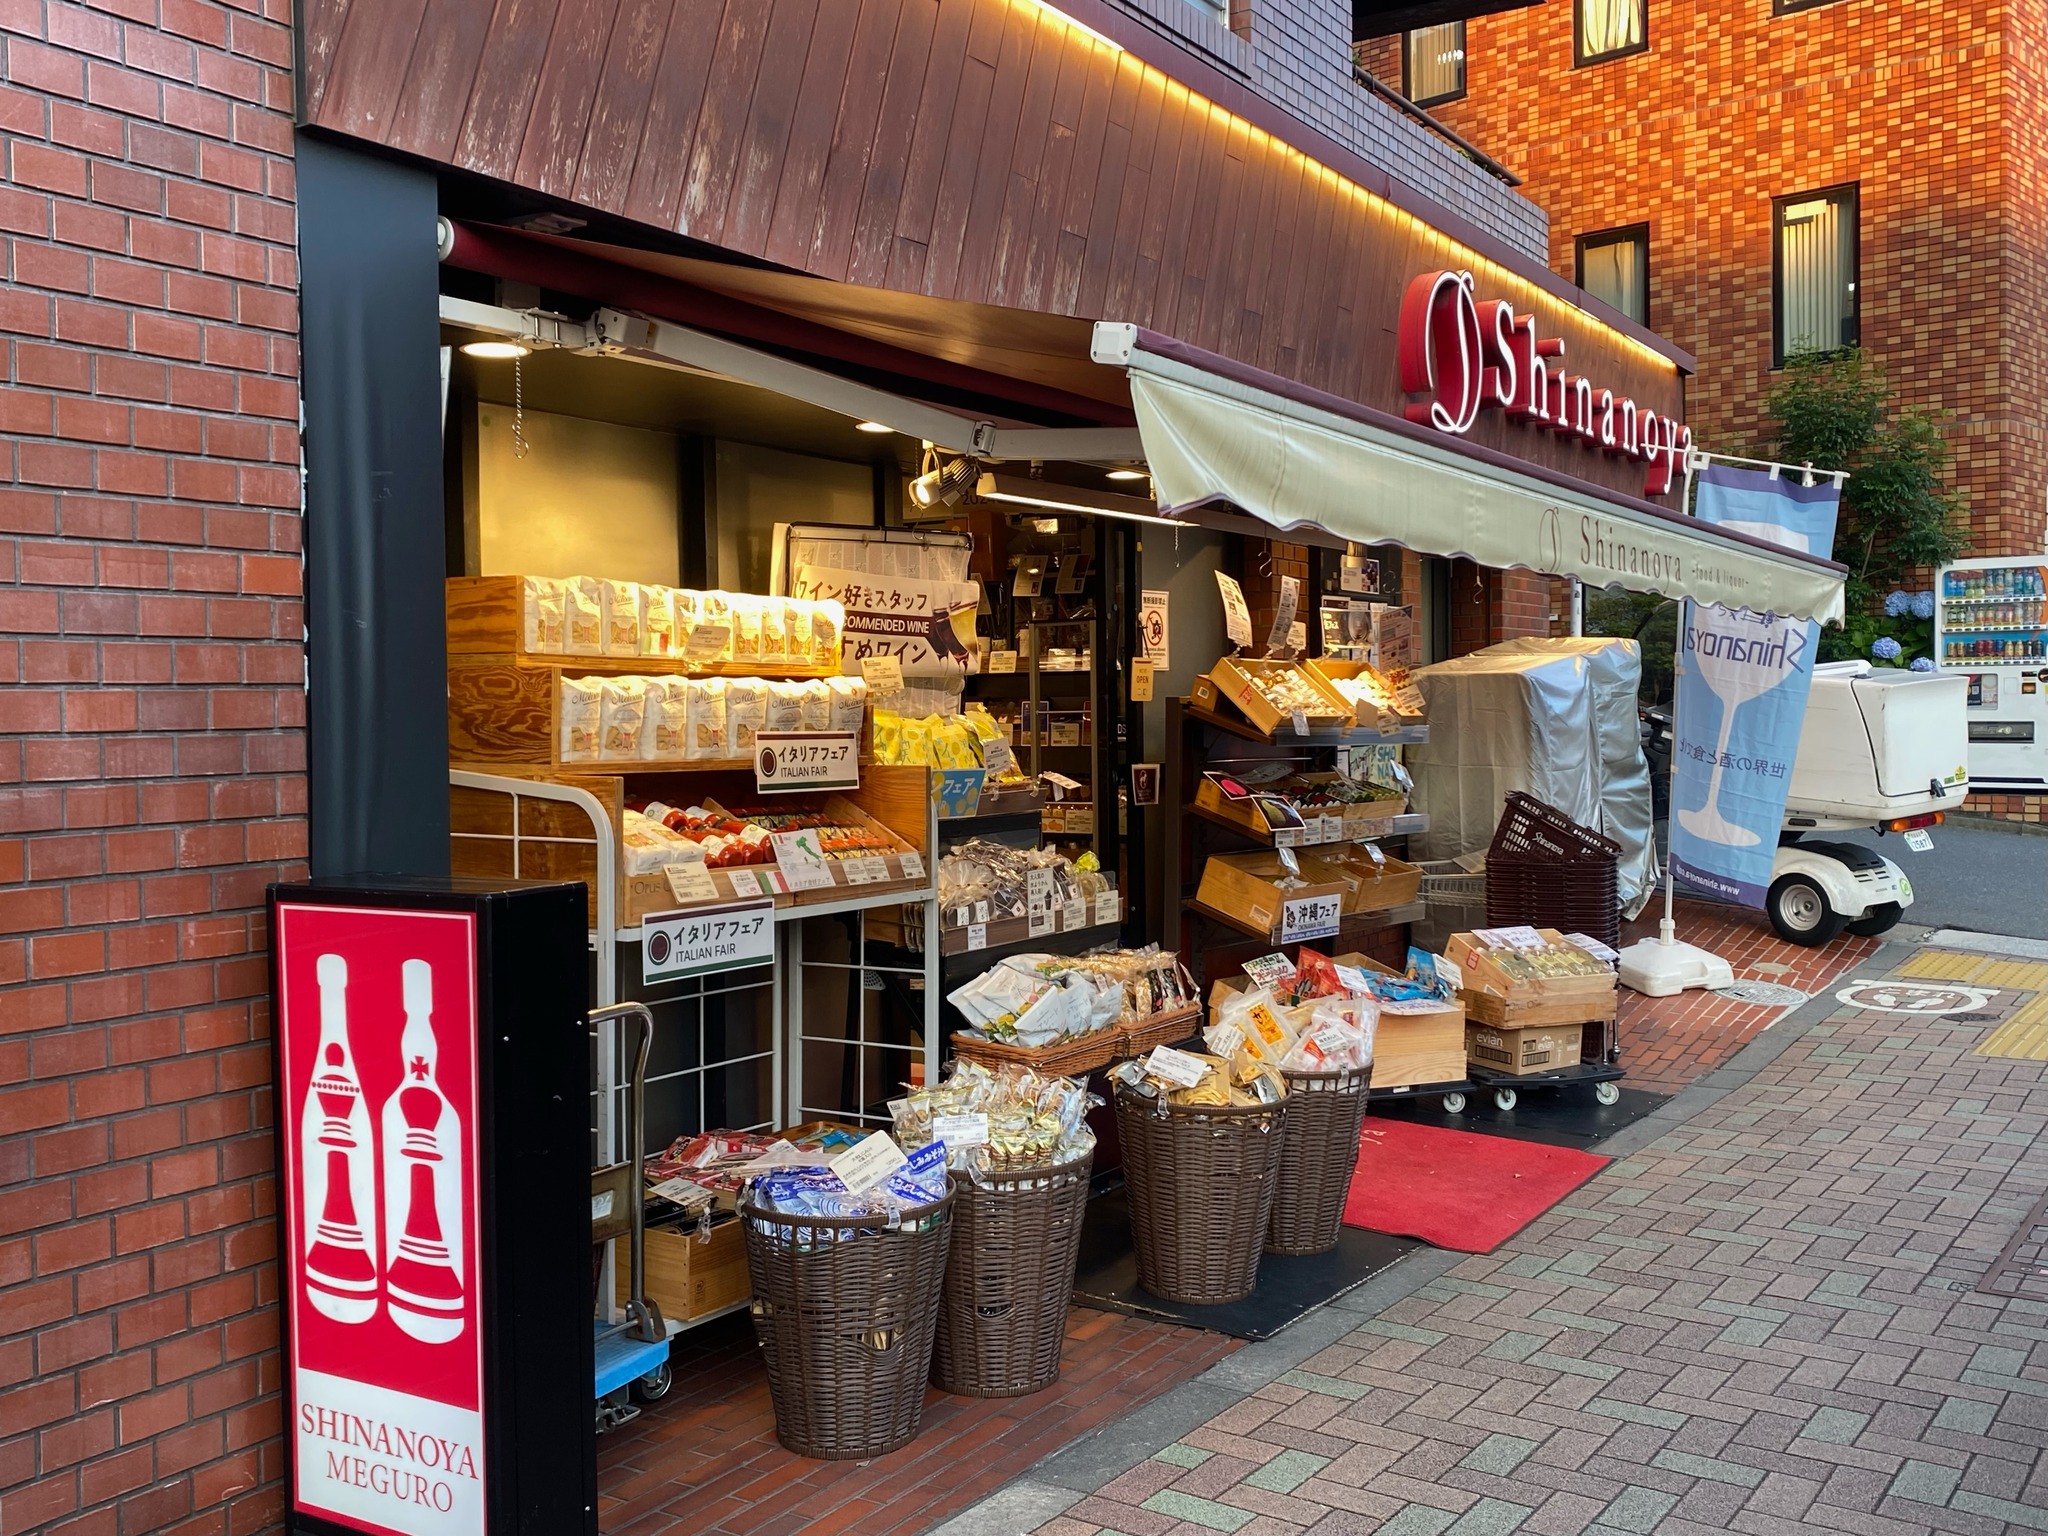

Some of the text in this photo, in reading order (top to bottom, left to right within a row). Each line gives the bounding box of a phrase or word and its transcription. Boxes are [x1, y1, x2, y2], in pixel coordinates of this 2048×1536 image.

[1495, 299, 1693, 495] Shinanoya
[1581, 515, 1682, 595] Shinanoya
[843, 615, 930, 634] COMMENDED WINE
[841, 636, 928, 664] すめワイン
[1136, 675, 1149, 684] OPEN
[778, 745, 849, 763] イタリアフェア
[780, 766, 828, 778] ITALIAN FAIR
[1298, 903, 1338, 923] 沖縄フェア
[673, 917, 765, 946] イタリアフェア
[675, 943, 736, 964] ITALIAN FAIR
[1476, 1032, 1503, 1048] evian
[1537, 1040, 1555, 1051] evian
[301, 1403, 480, 1480] SHINANOYA
[326, 1451, 453, 1513] MEGURO
